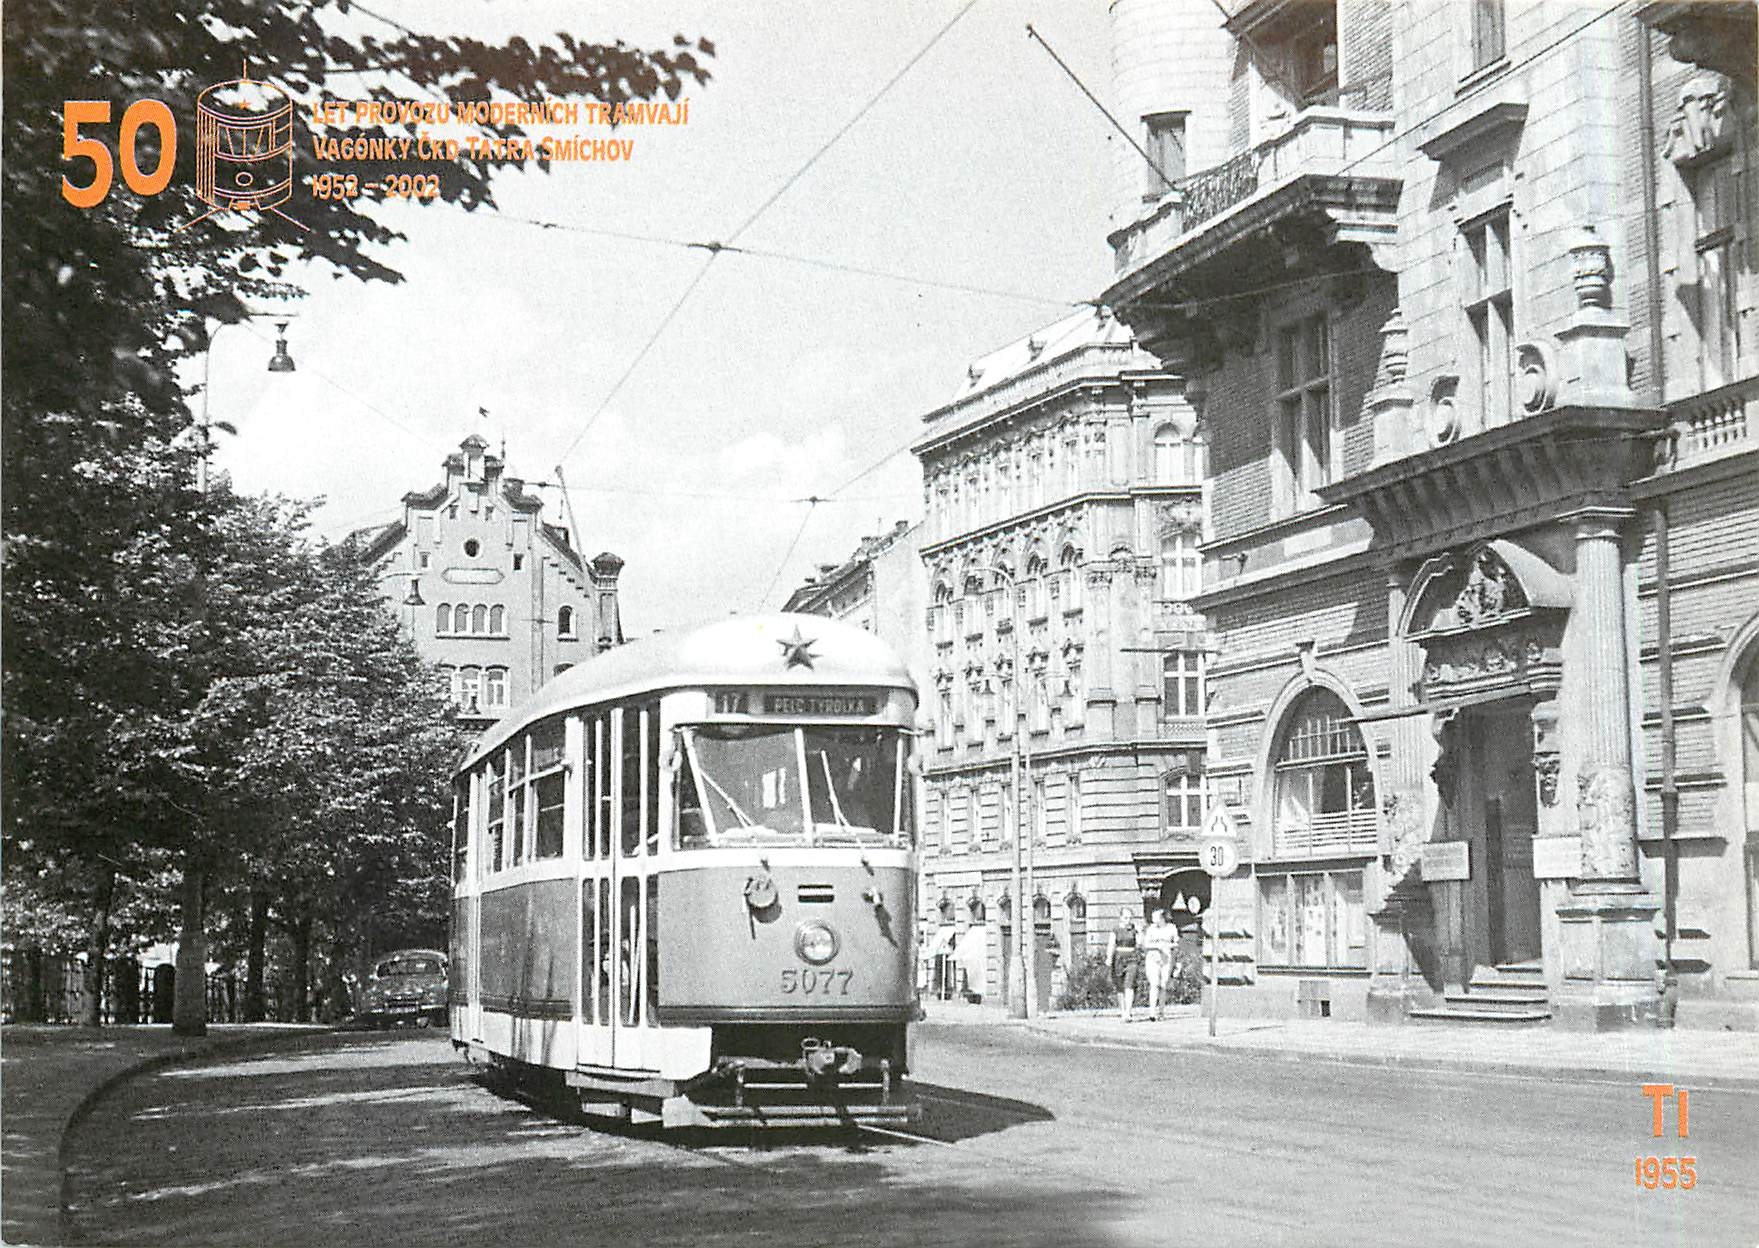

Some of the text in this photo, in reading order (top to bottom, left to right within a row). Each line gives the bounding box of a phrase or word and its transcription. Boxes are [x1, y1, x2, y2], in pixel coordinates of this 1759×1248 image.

[721, 692, 741, 714] 17
[1210, 846, 1224, 867] 30
[781, 968, 854, 996] 5077
